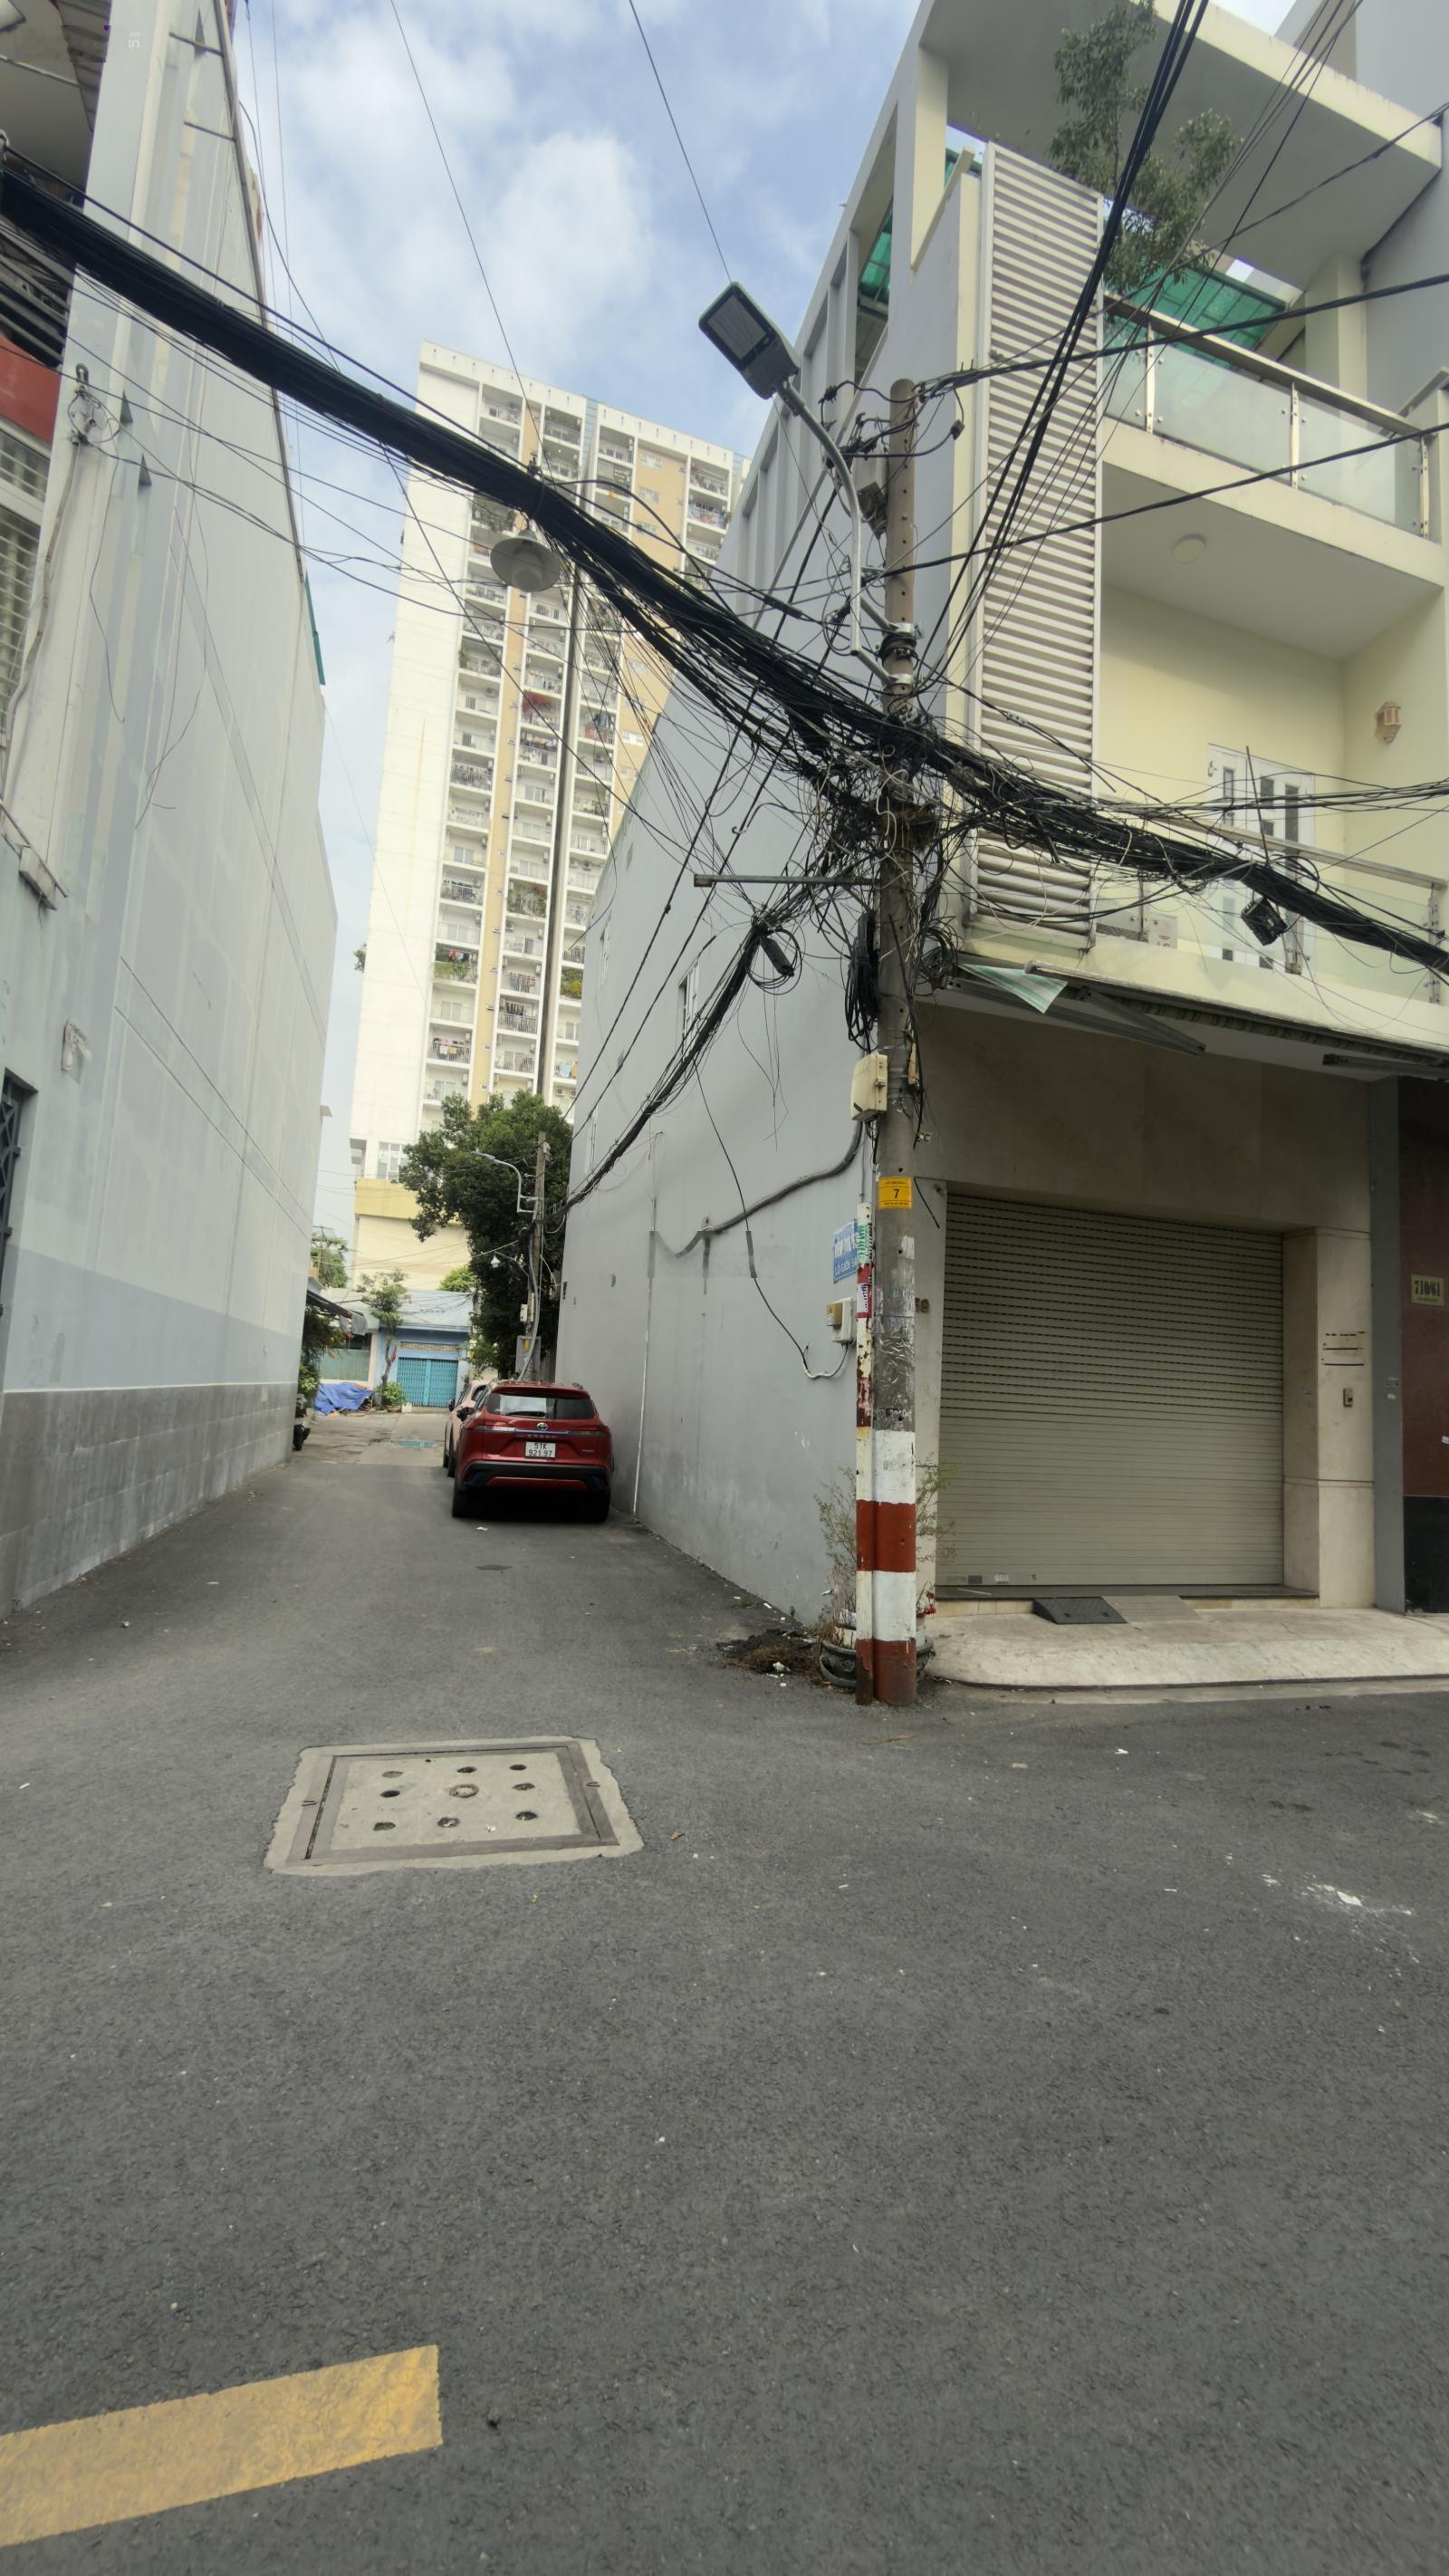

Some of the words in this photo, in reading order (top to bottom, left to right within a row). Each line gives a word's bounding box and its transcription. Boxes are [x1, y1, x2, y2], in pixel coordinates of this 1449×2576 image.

[893, 1188, 899, 1199] 7
[533, 1442, 547, 1450] 51K
[528, 1449, 552, 1457] 921.97
